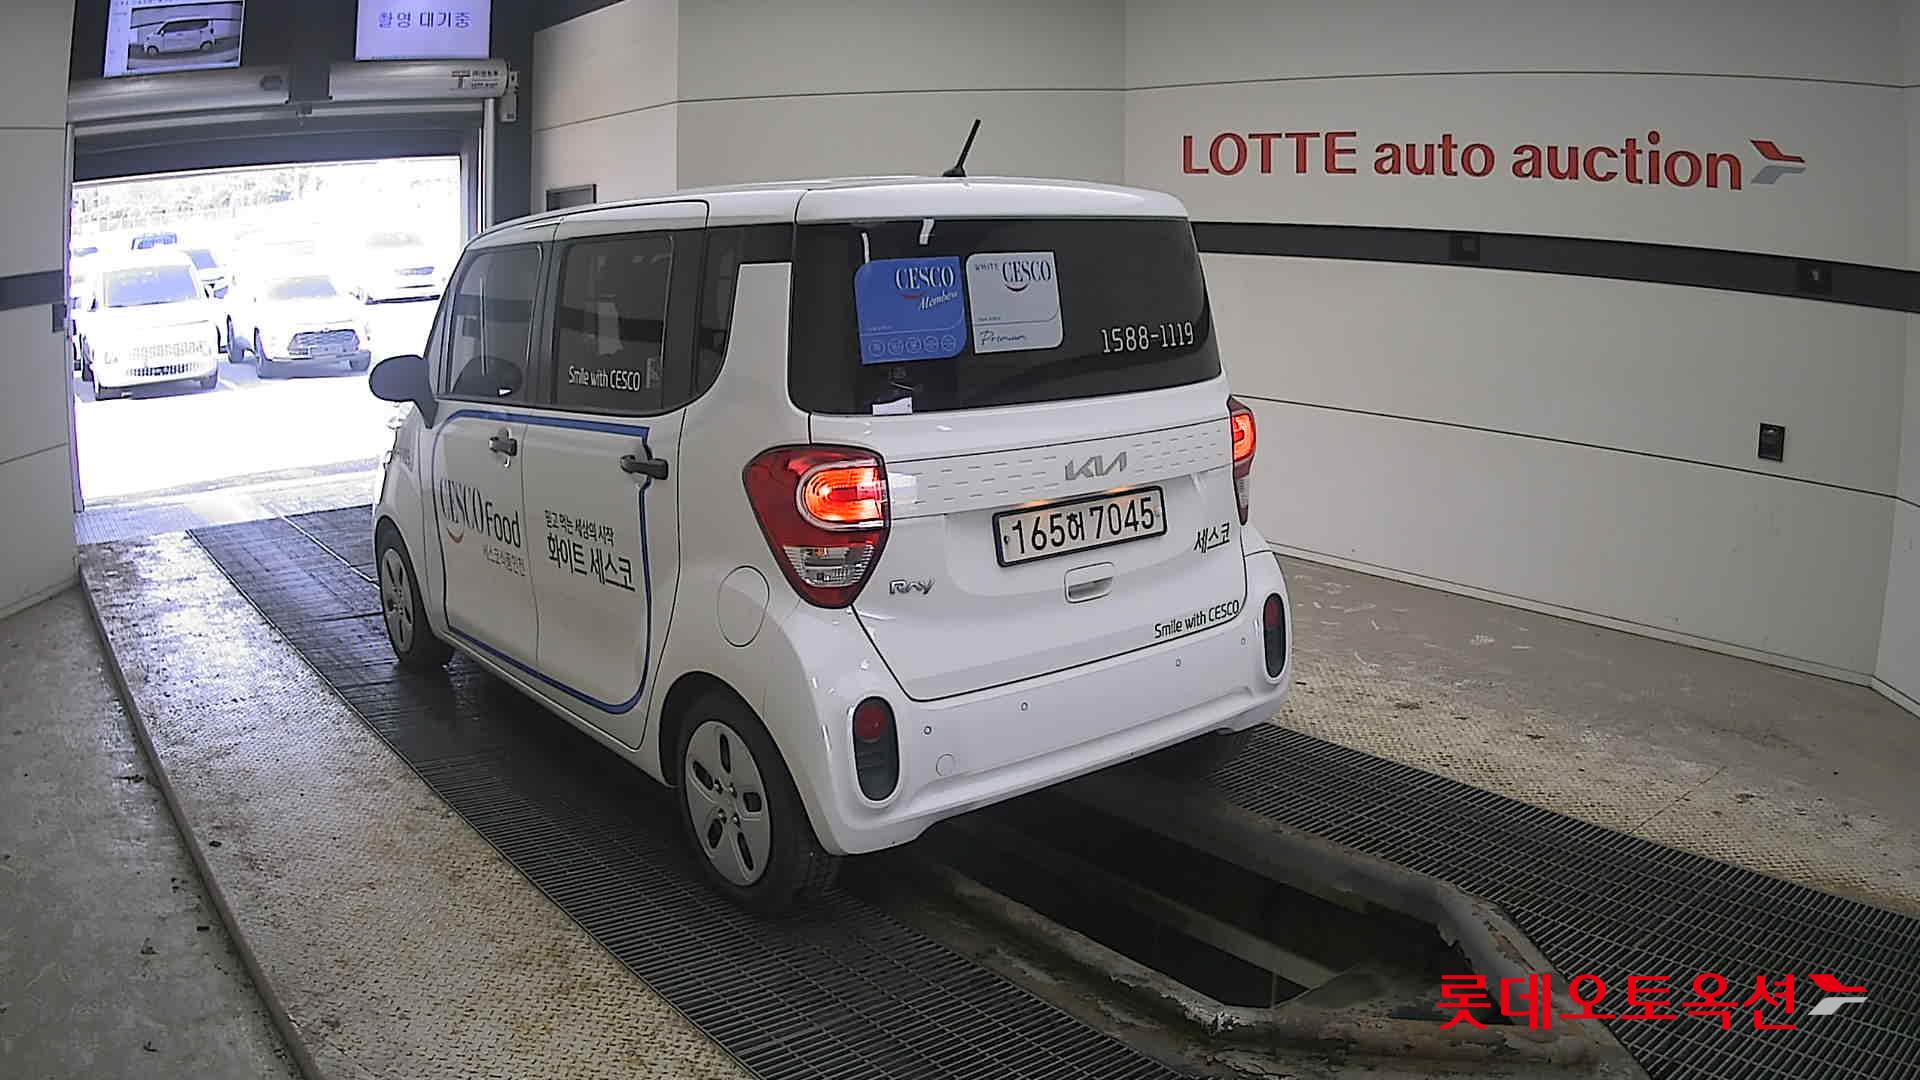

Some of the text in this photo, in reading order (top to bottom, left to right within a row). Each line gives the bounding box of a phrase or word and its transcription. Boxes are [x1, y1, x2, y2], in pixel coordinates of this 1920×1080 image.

[419, 11, 472, 29] 대기중
[1182, 129, 1743, 191] LOTTE auto auction
[896, 265, 955, 290] CESCO
[1002, 260, 1052, 283] CESCO
[1100, 321, 1195, 354] 1588-1119
[568, 364, 641, 392] Smile with CESCO
[1064, 451, 1128, 481] KIA
[439, 479, 521, 549] CESCO Food
[1011, 497, 1156, 556] 165허 7045
[1193, 521, 1231, 554] 세스코
[547, 532, 636, 592] 화이트 세스코
[1154, 600, 1240, 640] Smile with CESCO
